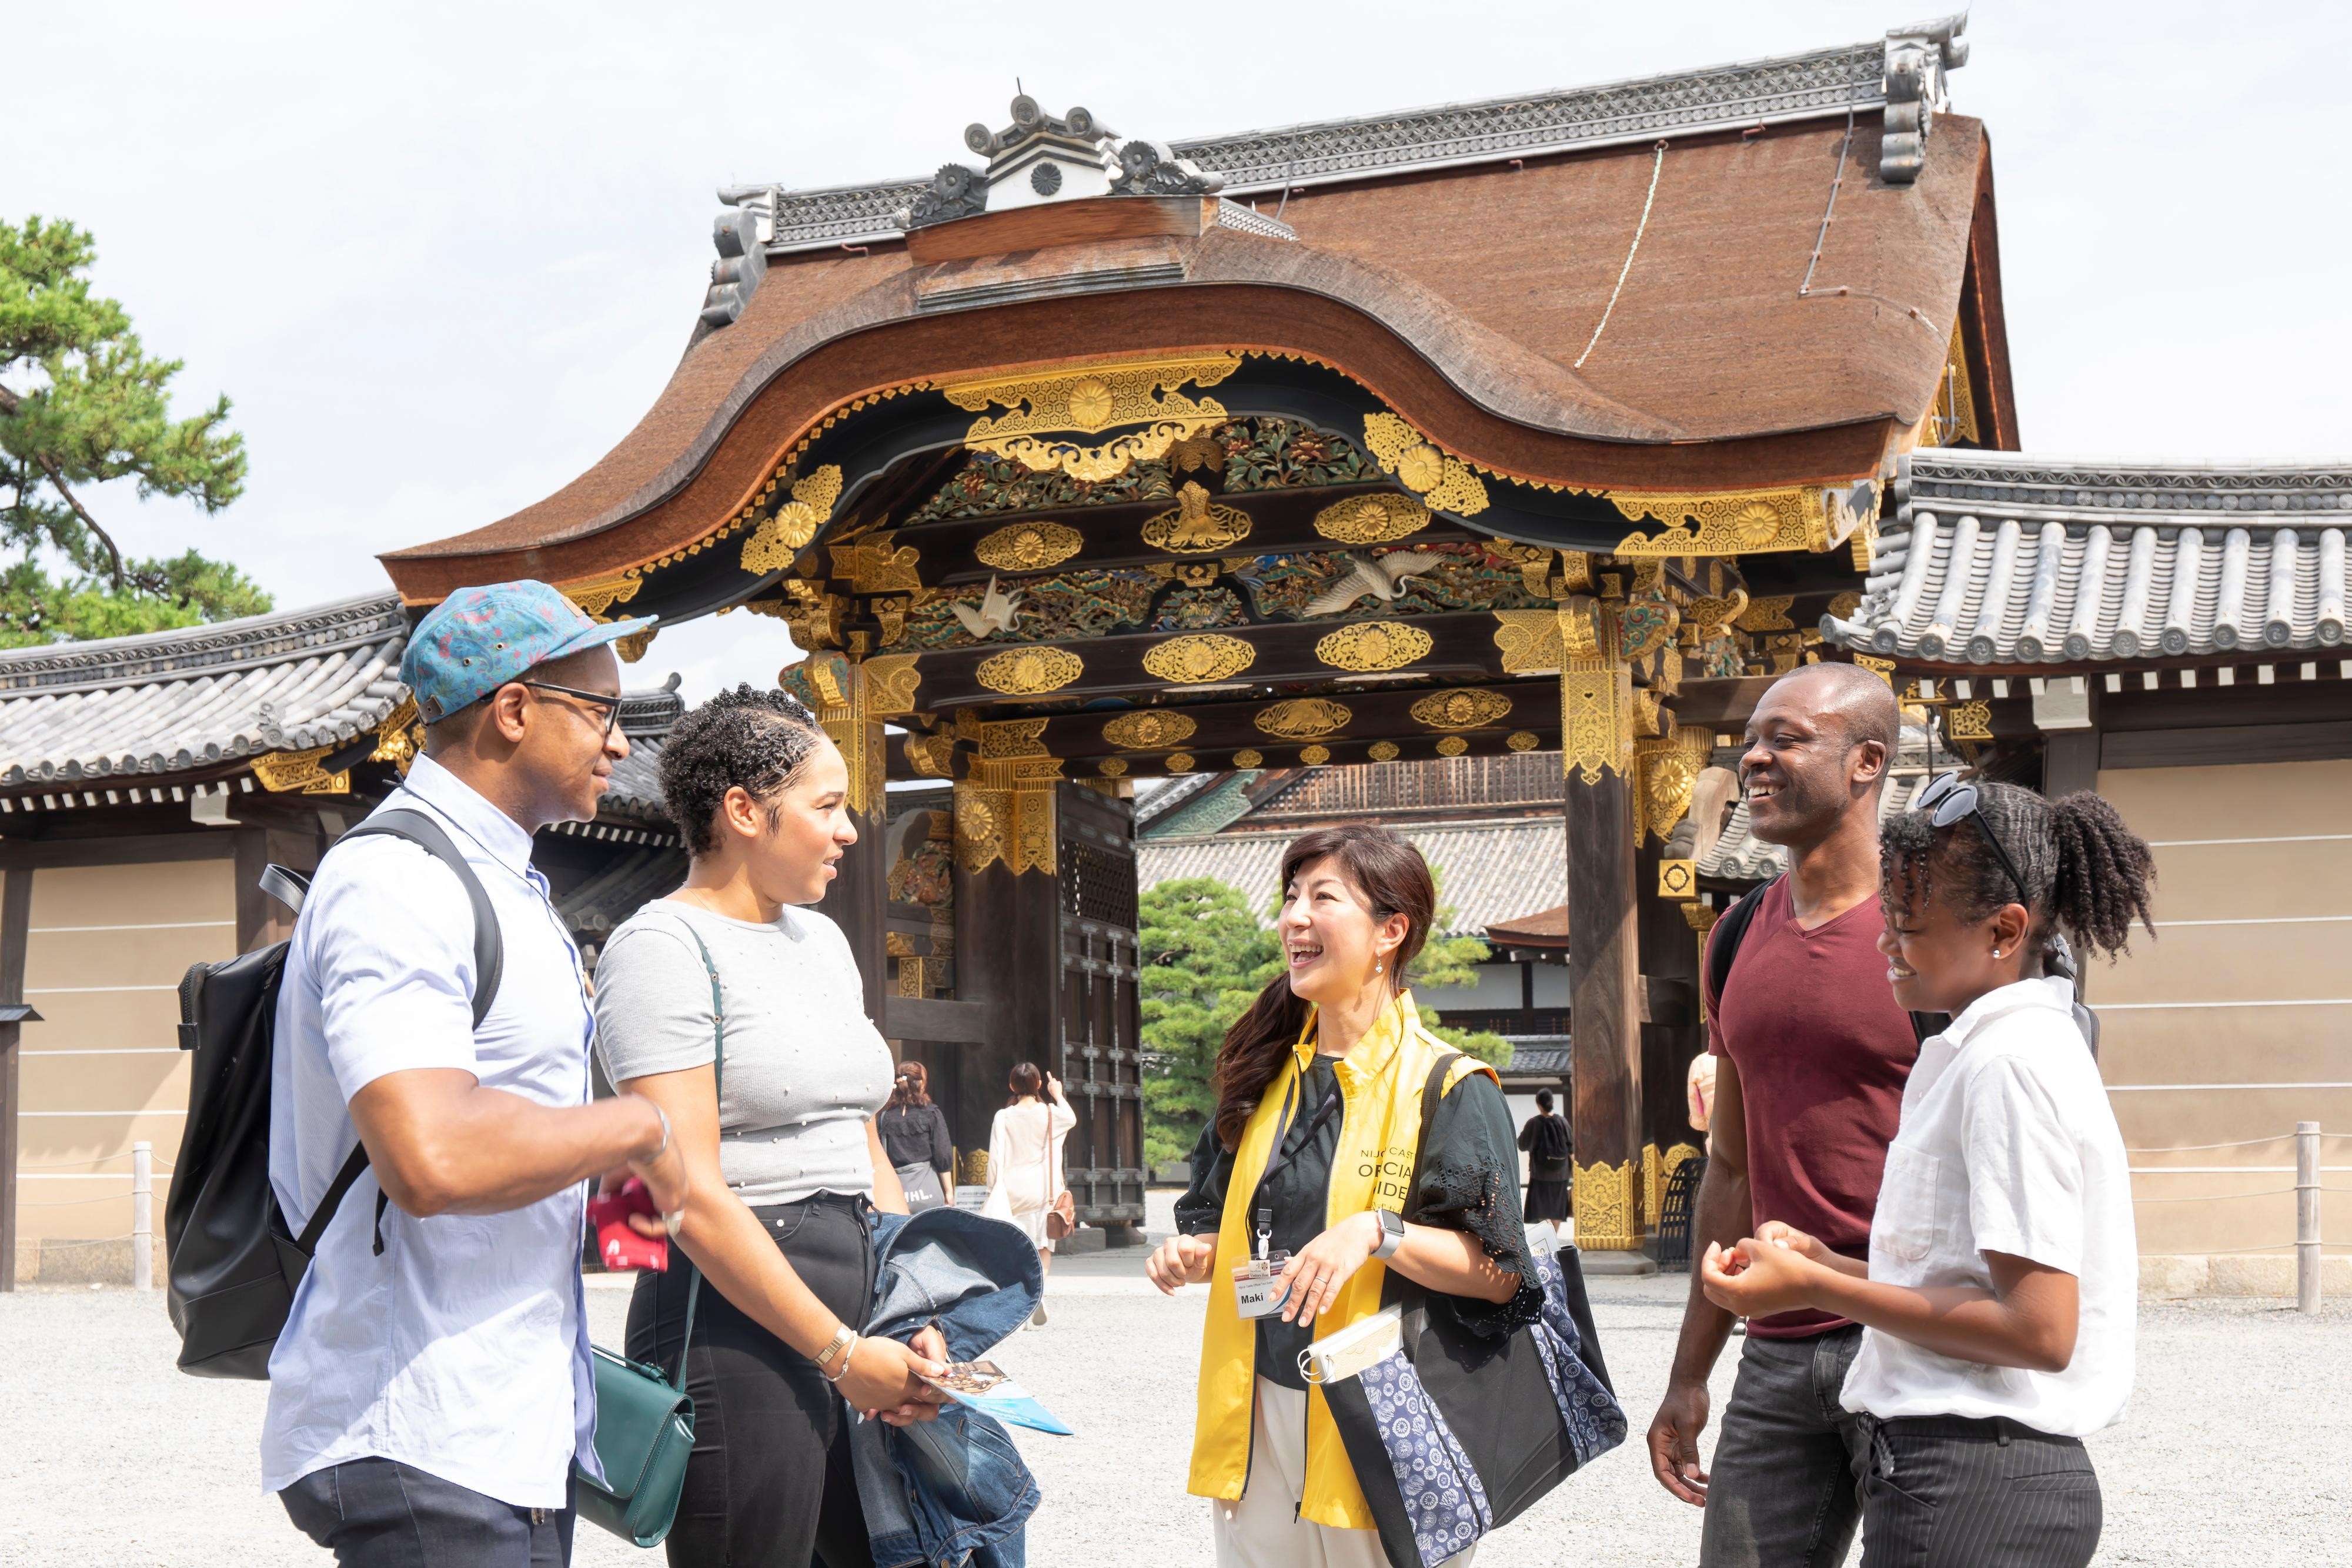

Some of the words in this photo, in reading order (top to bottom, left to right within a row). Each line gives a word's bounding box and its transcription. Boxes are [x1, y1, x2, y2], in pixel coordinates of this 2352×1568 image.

[1389, 1147, 1415, 1159] CAST
[1358, 1162, 1411, 1180] OFCIA
[1374, 1181, 1408, 1200] IDE
[1241, 1293, 1264, 1304] Maki
